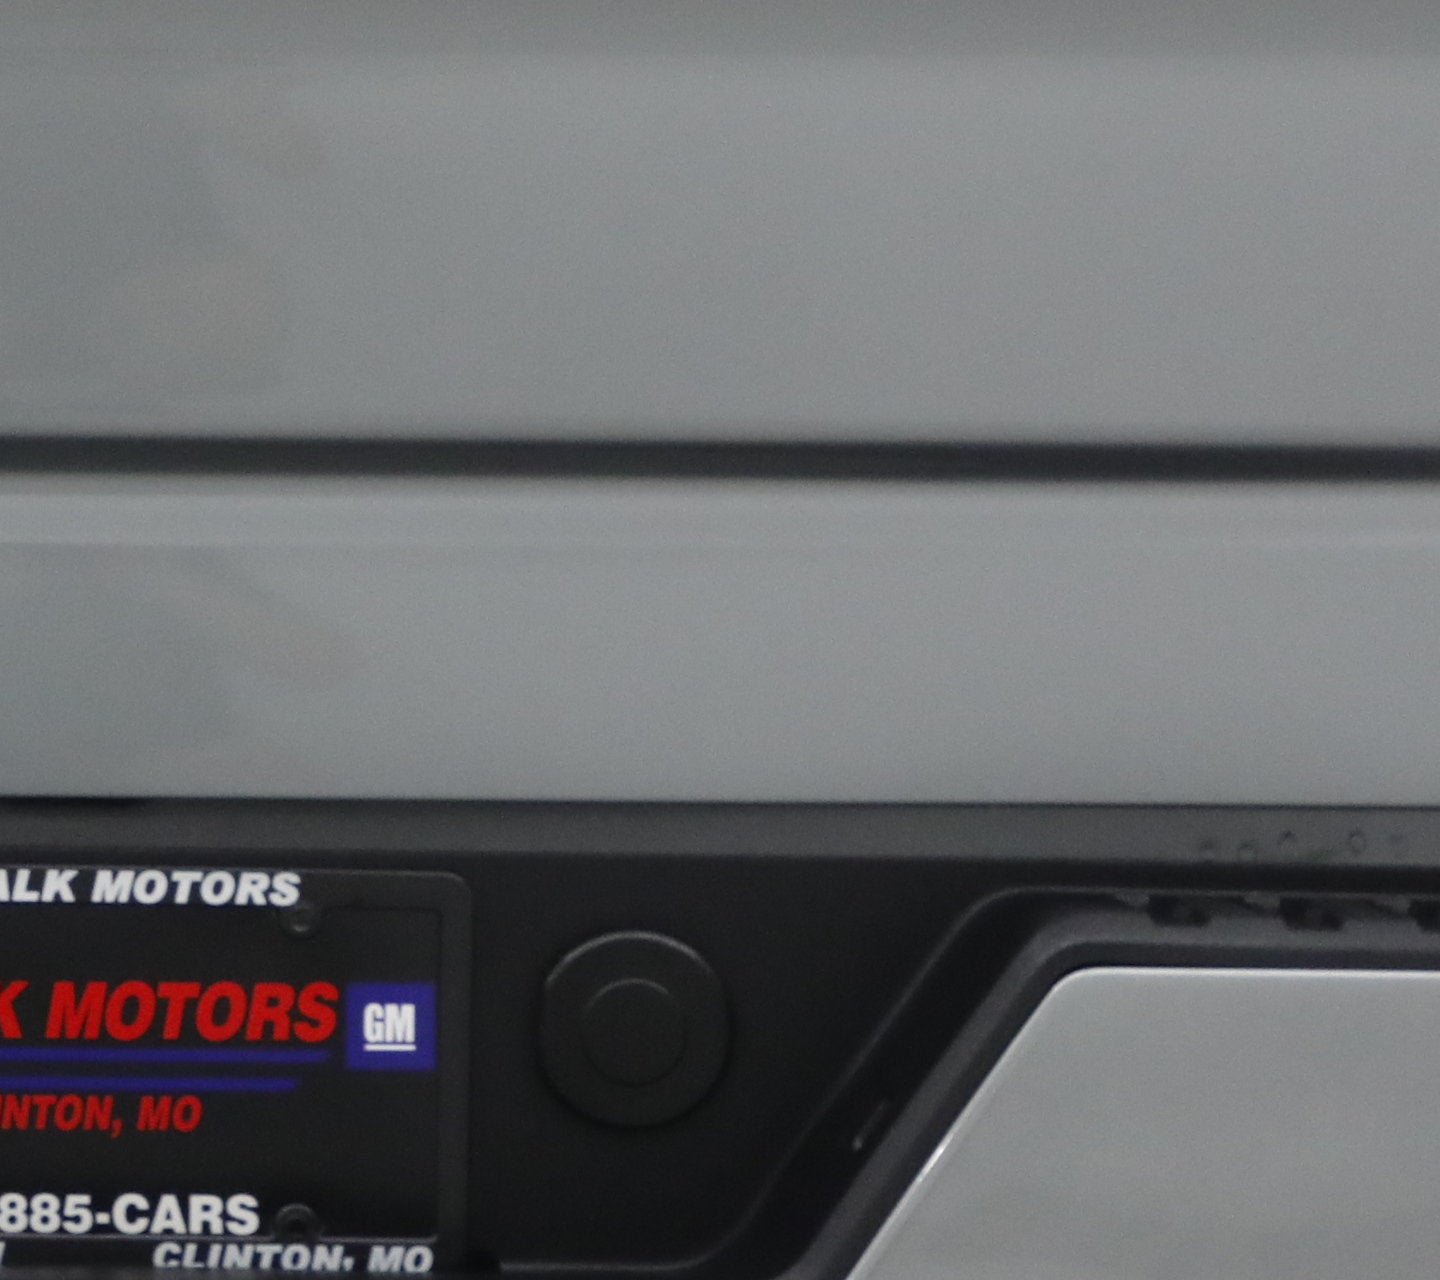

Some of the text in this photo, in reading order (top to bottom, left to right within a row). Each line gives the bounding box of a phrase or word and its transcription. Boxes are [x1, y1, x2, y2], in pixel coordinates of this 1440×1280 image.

[90, 869, 302, 907] MOTORS
[44, 979, 340, 1043] MOTORS
[362, 1001, 418, 1045] GM
[135, 1094, 204, 1133] MO
[366, 1244, 435, 1274] MO
